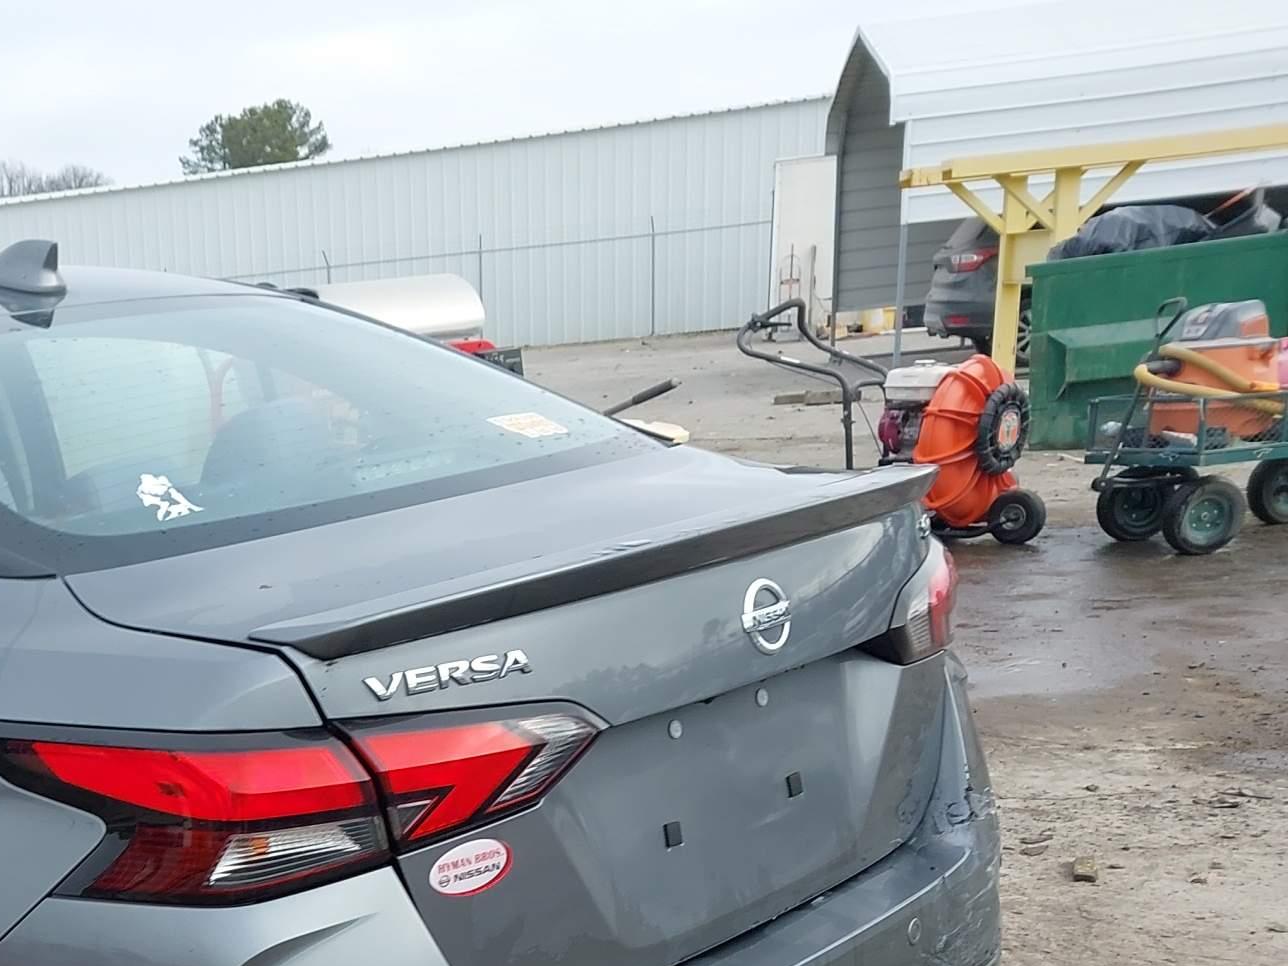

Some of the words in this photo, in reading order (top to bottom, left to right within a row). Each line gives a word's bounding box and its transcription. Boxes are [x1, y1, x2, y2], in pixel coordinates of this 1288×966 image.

[361, 649, 532, 701] VERSA
[437, 856, 473, 875] HYMAN
[453, 861, 502, 882] NISSAN
